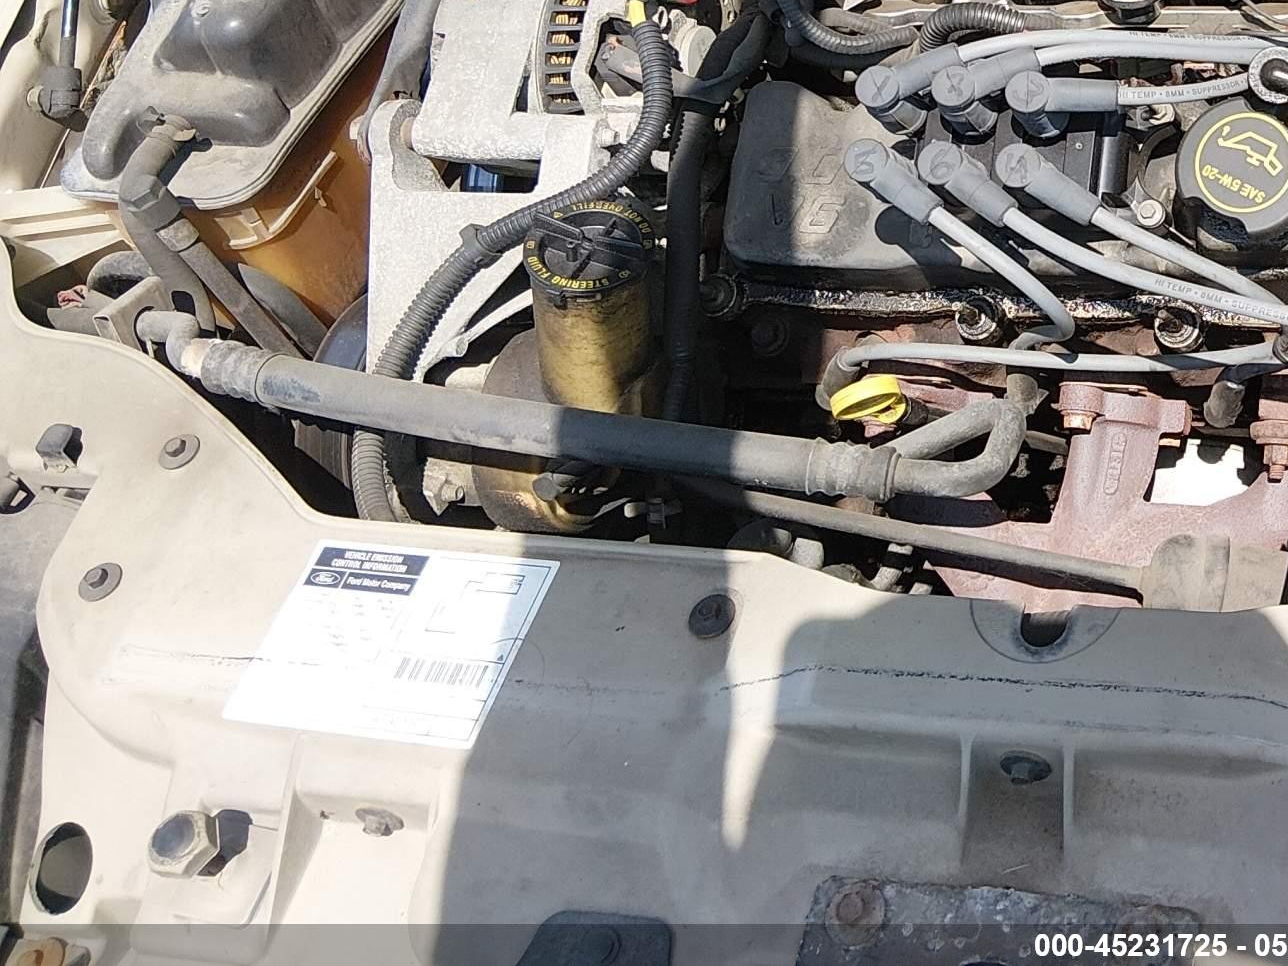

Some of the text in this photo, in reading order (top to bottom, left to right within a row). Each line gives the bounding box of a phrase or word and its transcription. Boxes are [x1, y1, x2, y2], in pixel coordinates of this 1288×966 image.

[1131, 90, 1157, 100] TEMP
[1191, 80, 1240, 96] SUPPRESSOR
[1201, 164, 1267, 204] SAE 5W-20
[571, 200, 625, 212] OVERFILL
[527, 256, 610, 290] STEERING FLUID
[1165, 280, 1192, 295] TEMP
